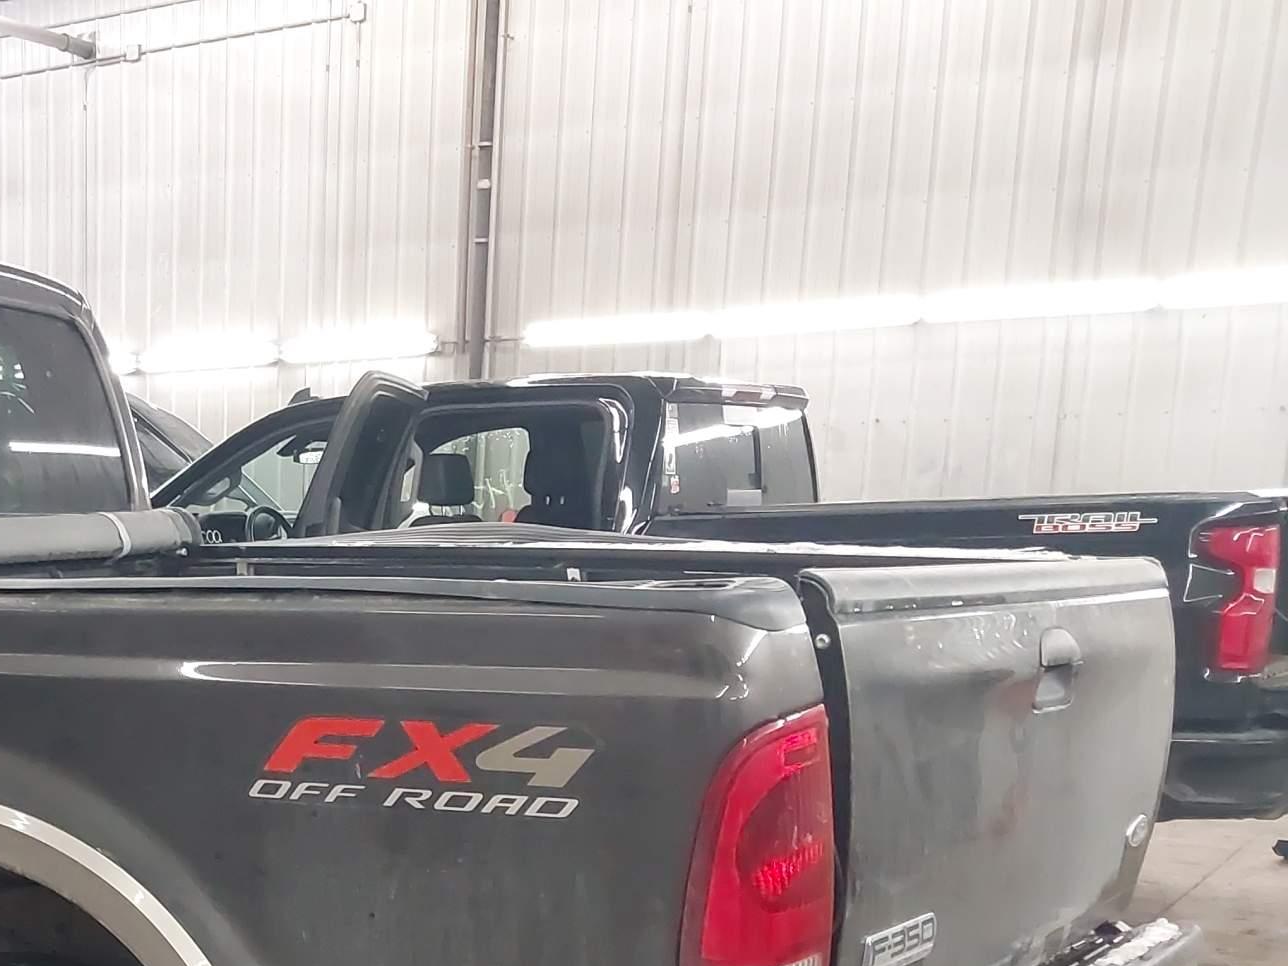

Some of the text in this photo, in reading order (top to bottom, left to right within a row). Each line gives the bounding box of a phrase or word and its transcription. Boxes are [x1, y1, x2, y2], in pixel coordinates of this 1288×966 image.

[1018, 511, 1158, 525] TRAIL
[264, 715, 596, 788] FX4
[248, 779, 579, 818] OFF ROAD
